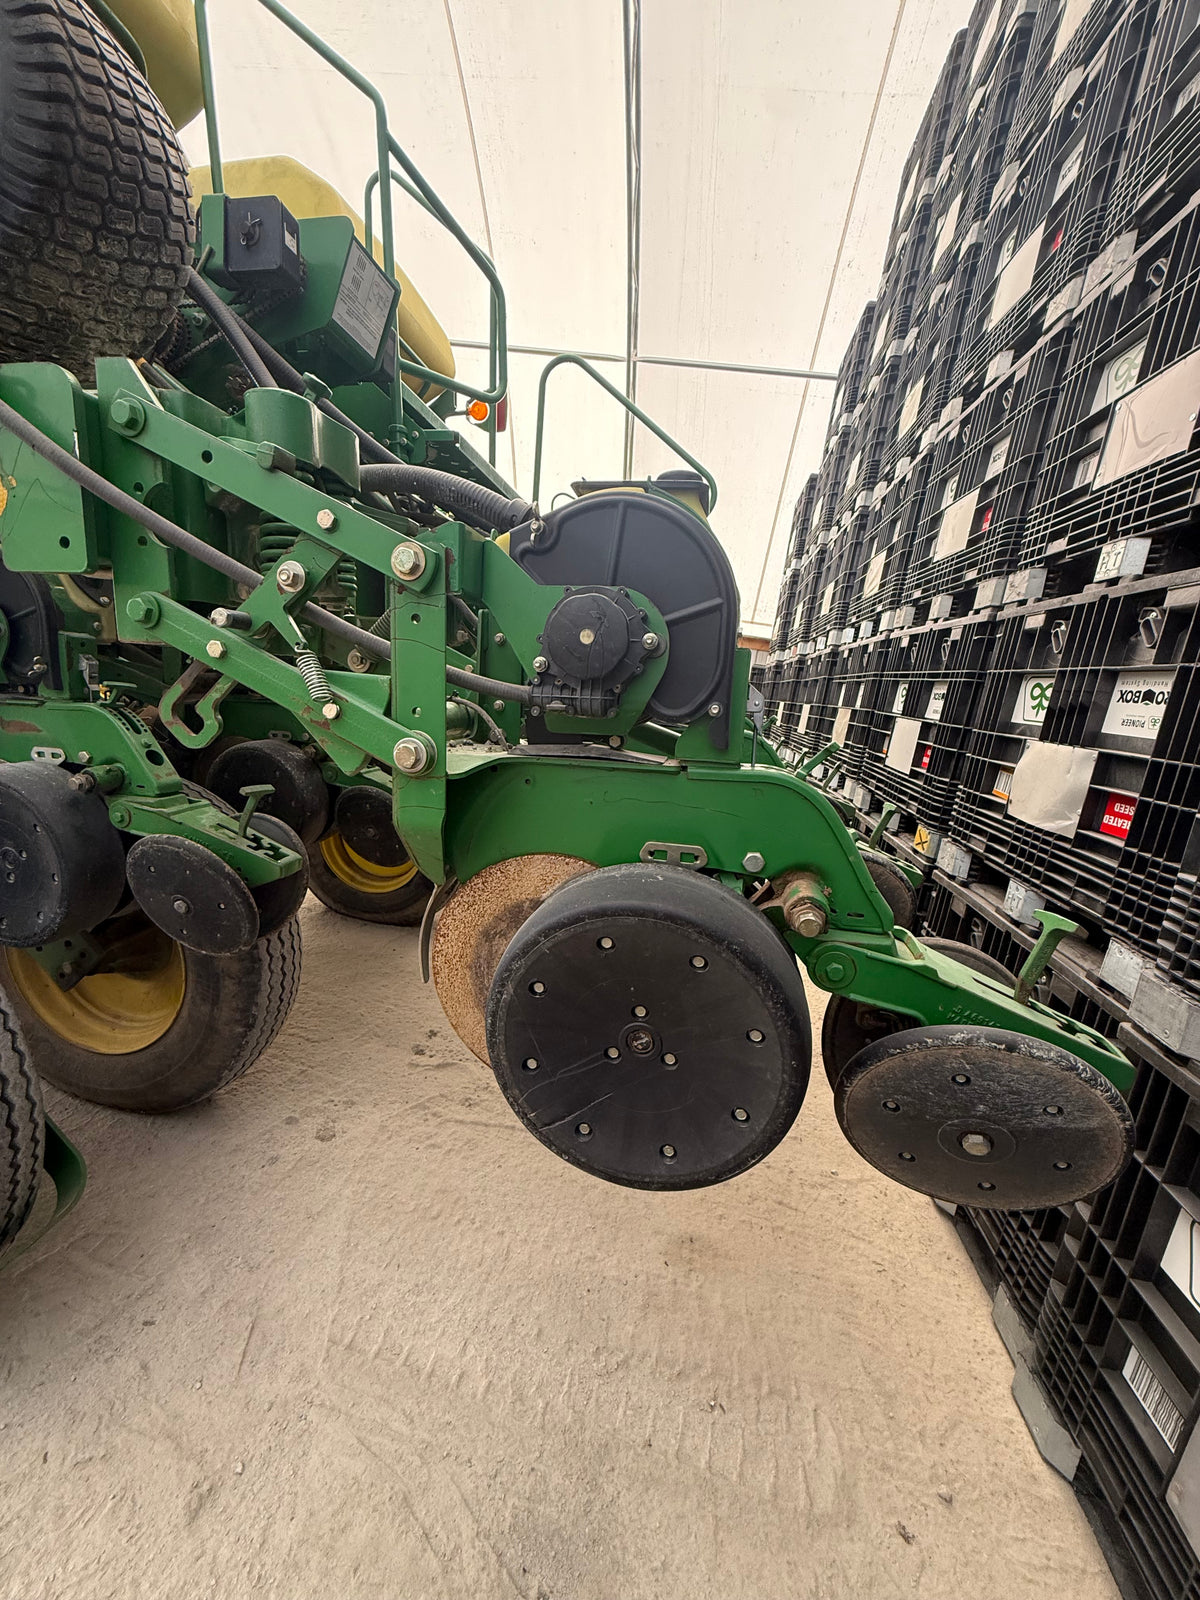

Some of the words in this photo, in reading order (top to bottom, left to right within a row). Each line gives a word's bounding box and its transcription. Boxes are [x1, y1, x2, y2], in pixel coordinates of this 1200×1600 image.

[1121, 679, 1141, 687] System
[1143, 679, 1169, 688] Handling
[1117, 689, 1142, 704] BOX
[1121, 718, 1146, 729] PIONEER
[1114, 802, 1136, 816] SEED
